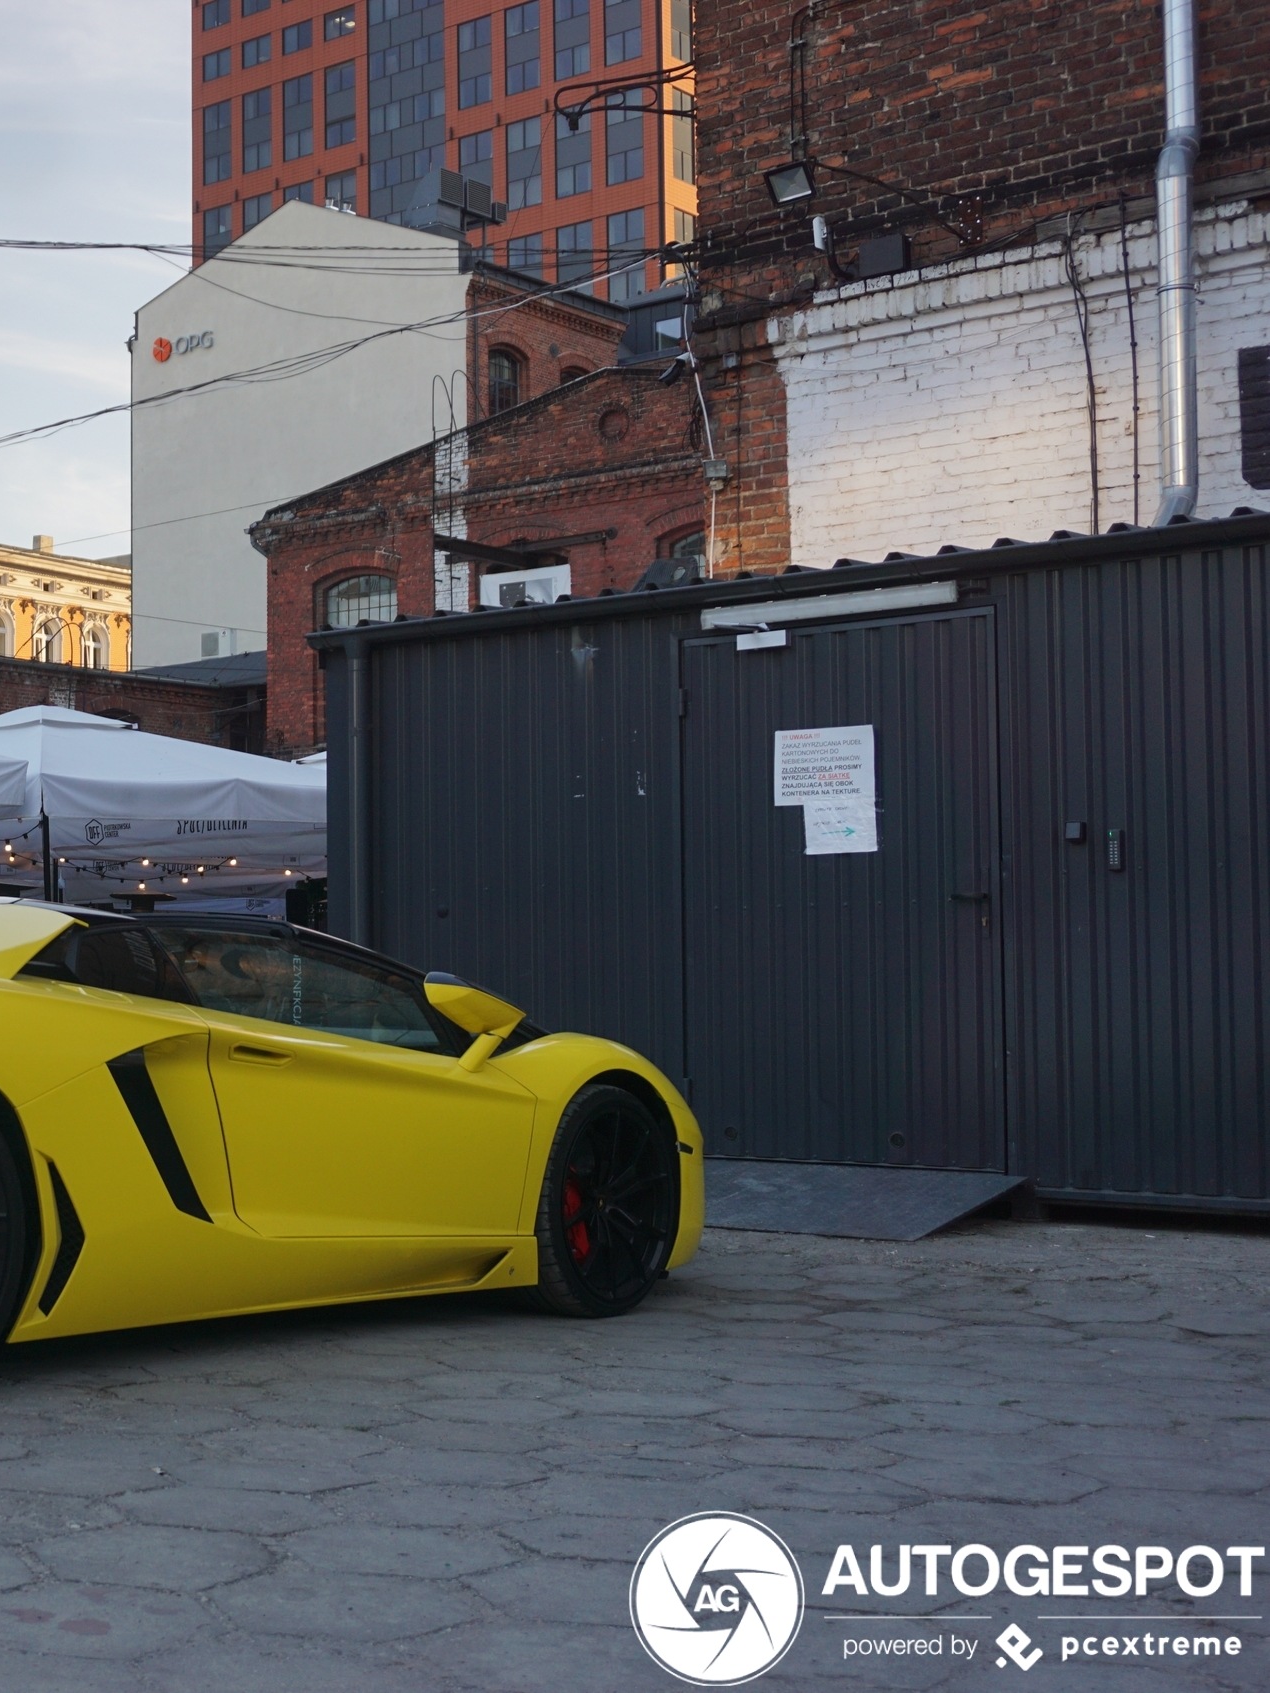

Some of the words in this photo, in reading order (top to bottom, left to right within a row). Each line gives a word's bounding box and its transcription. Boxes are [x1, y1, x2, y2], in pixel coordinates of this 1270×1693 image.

[175, 330, 214, 354] OPG
[802, 740, 842, 748] WYRZUCANIA
[781, 766, 811, 774] ZŁOŻONE
[834, 763, 863, 771] PROSIMY
[781, 773, 817, 781] WYRZUCAĆ
[781, 781, 823, 789] ZNAJDUJĄCĄ
[103, 822, 131, 831] PIOTRKOWSKA
[104, 830, 119, 838] CENTER
